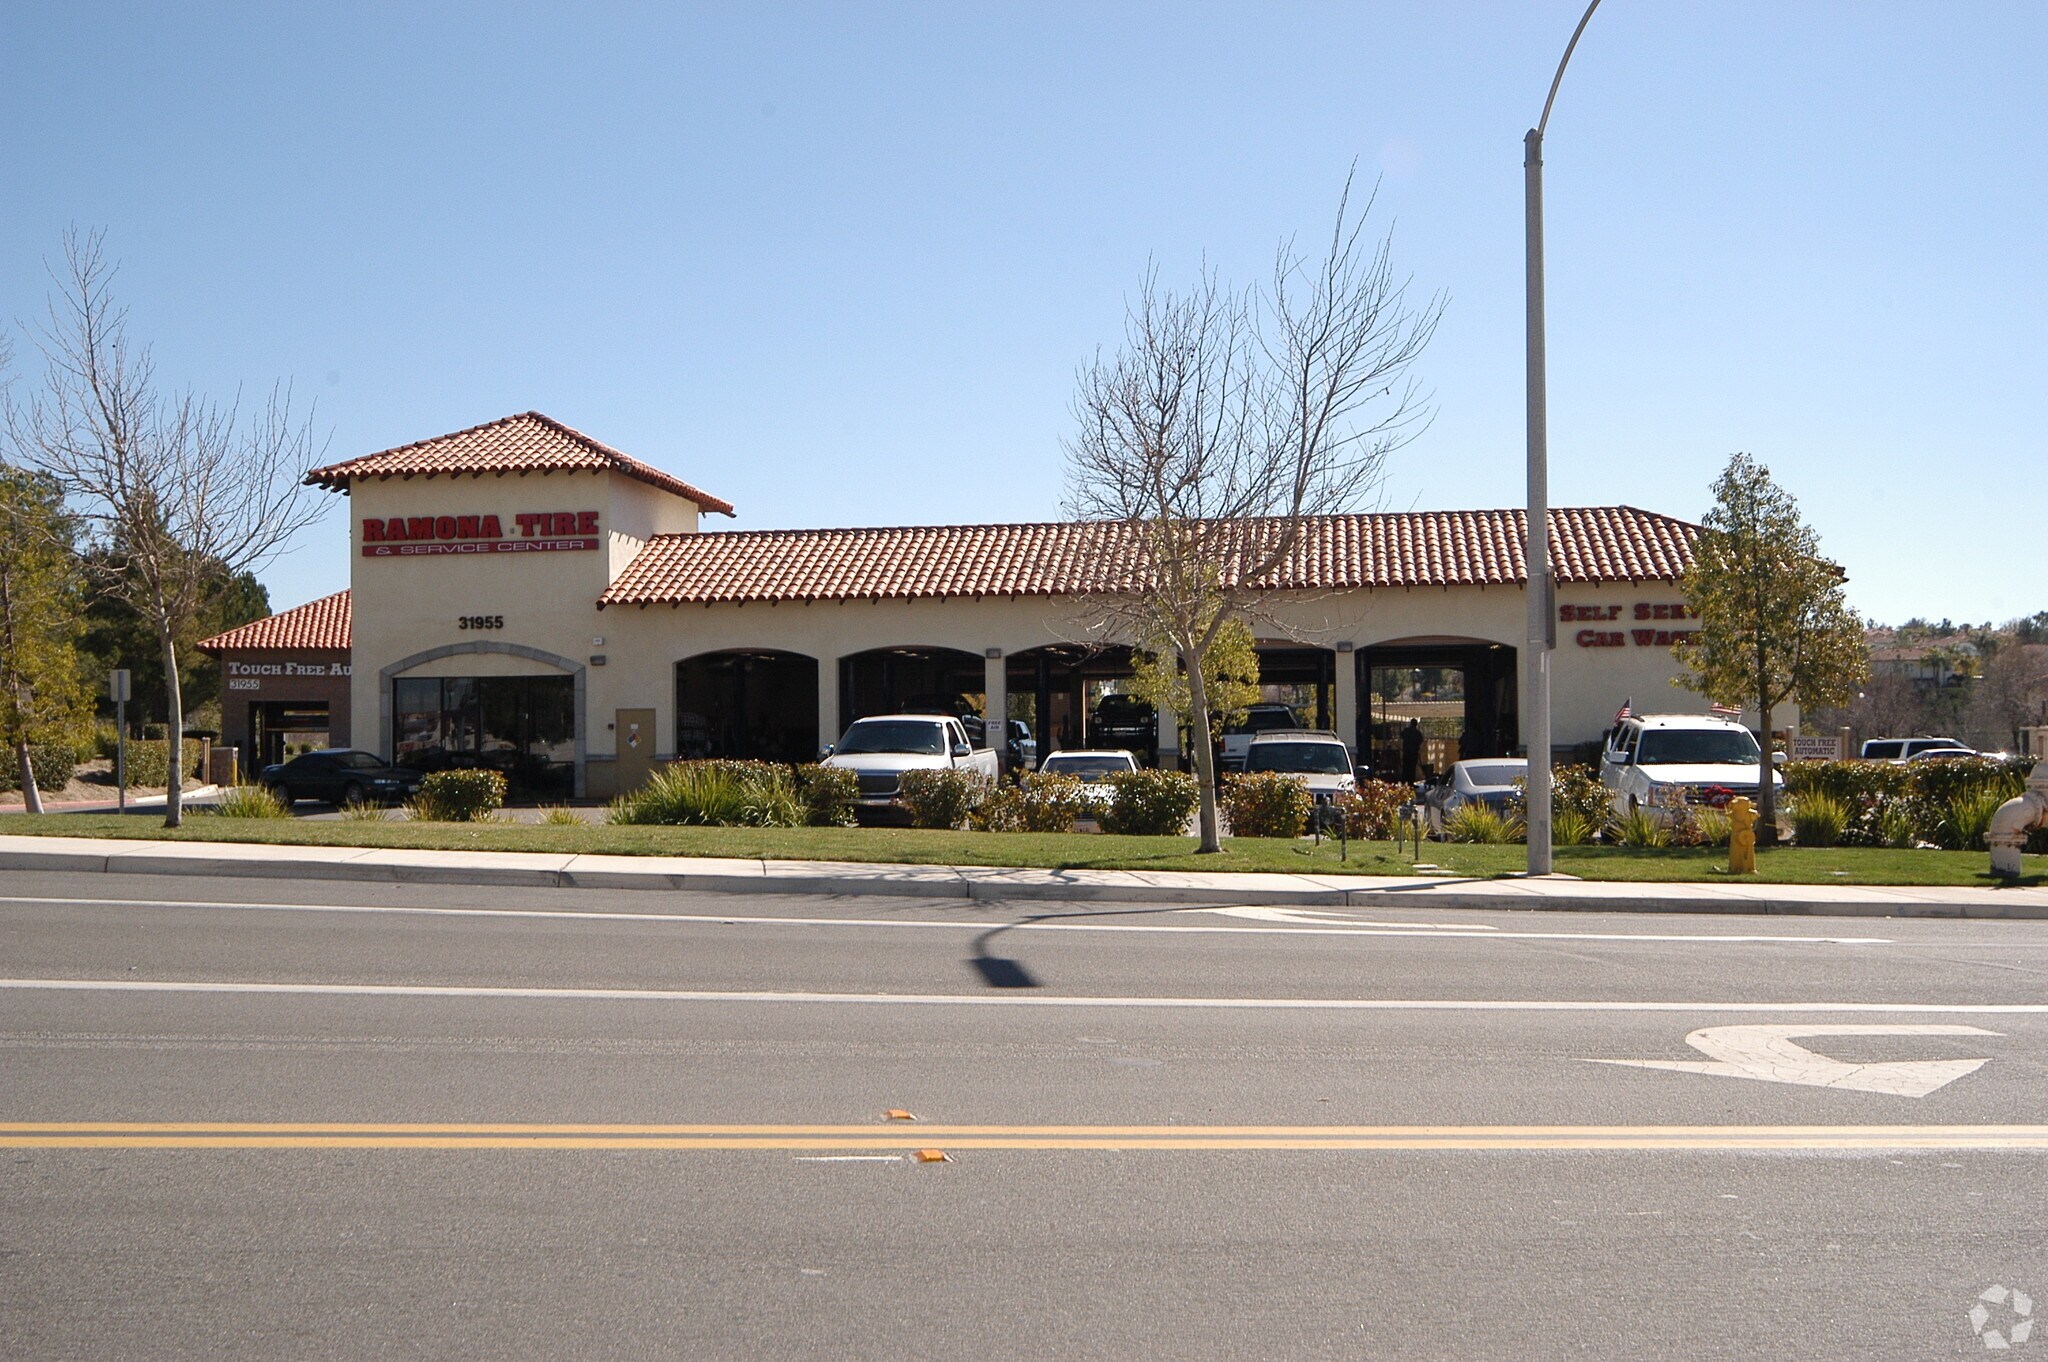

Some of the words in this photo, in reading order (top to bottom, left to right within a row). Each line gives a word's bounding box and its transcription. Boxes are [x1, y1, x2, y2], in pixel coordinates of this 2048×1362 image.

[363, 515, 503, 541] RAMONA
[516, 511, 599, 537] TIRE
[376, 546, 392, 555] &
[401, 543, 489, 554] SERVICE
[497, 540, 585, 552] CENTER
[1559, 604, 1622, 622] SELF
[458, 615, 504, 630] 31955
[1576, 629, 1625, 648] CAR
[228, 661, 281, 675] TOUCH
[285, 661, 326, 676] FREE
[230, 679, 259, 689] 31955
[1793, 738, 1816, 747] TOUCH
[1817, 738, 1837, 747] FREE
[1794, 747, 1836, 755] AUTOMATIC
